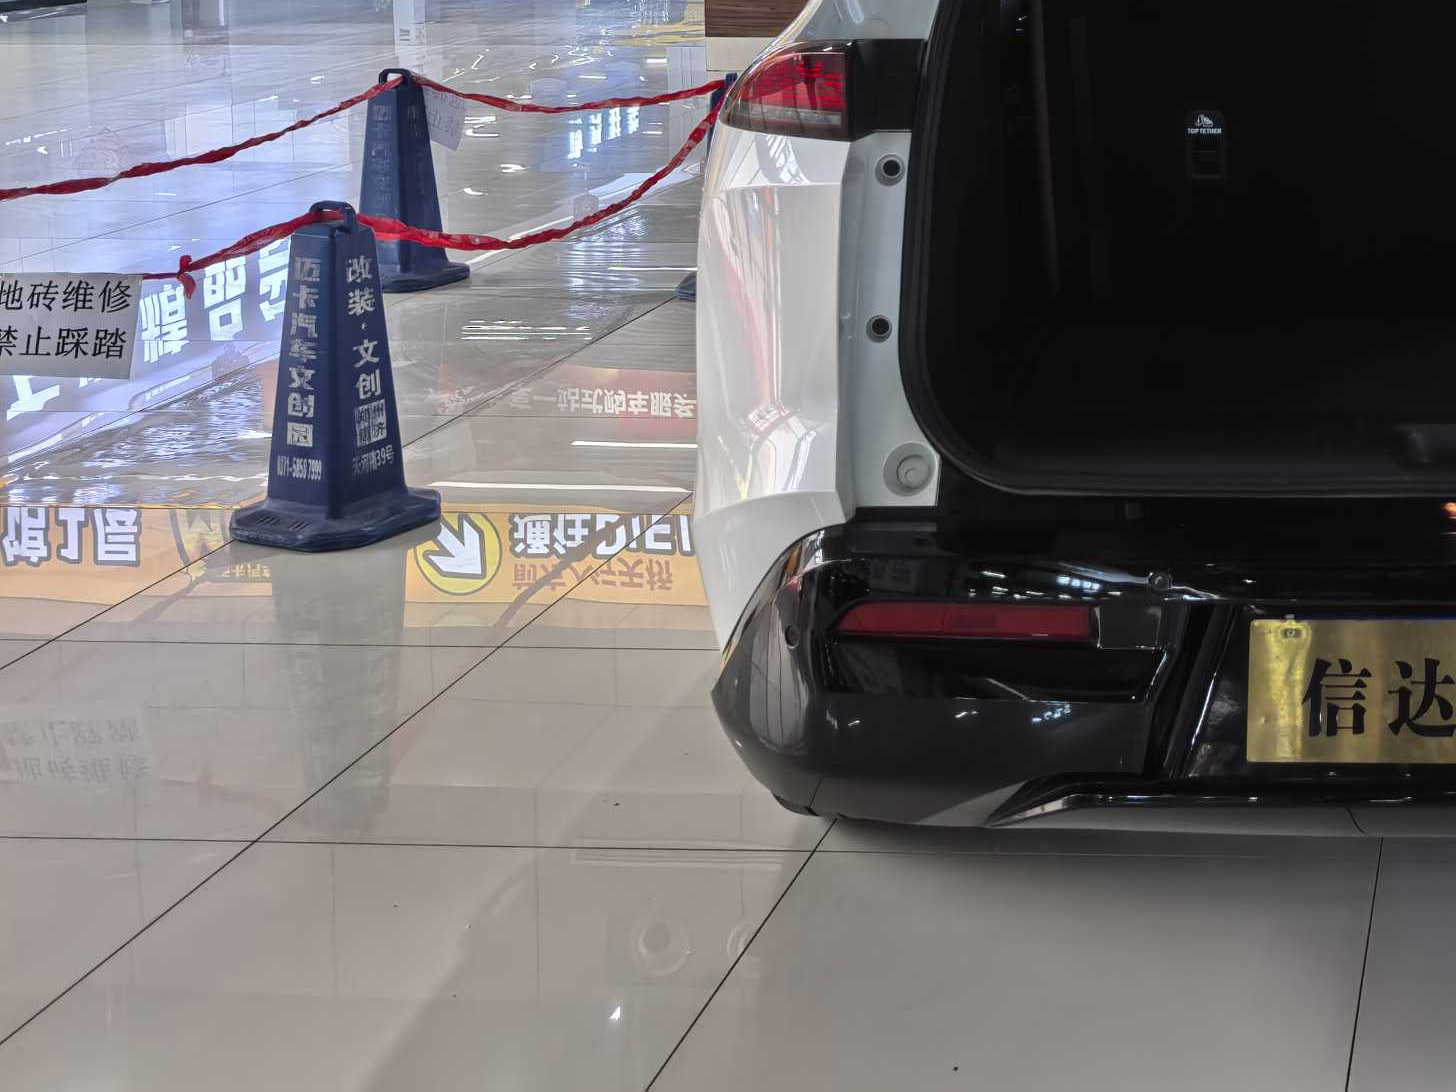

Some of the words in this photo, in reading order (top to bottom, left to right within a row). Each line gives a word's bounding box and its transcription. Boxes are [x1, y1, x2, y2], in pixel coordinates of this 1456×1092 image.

[0, 279, 133, 314] 地砖维修
[287, 257, 322, 448] 迈卡汽车文创园
